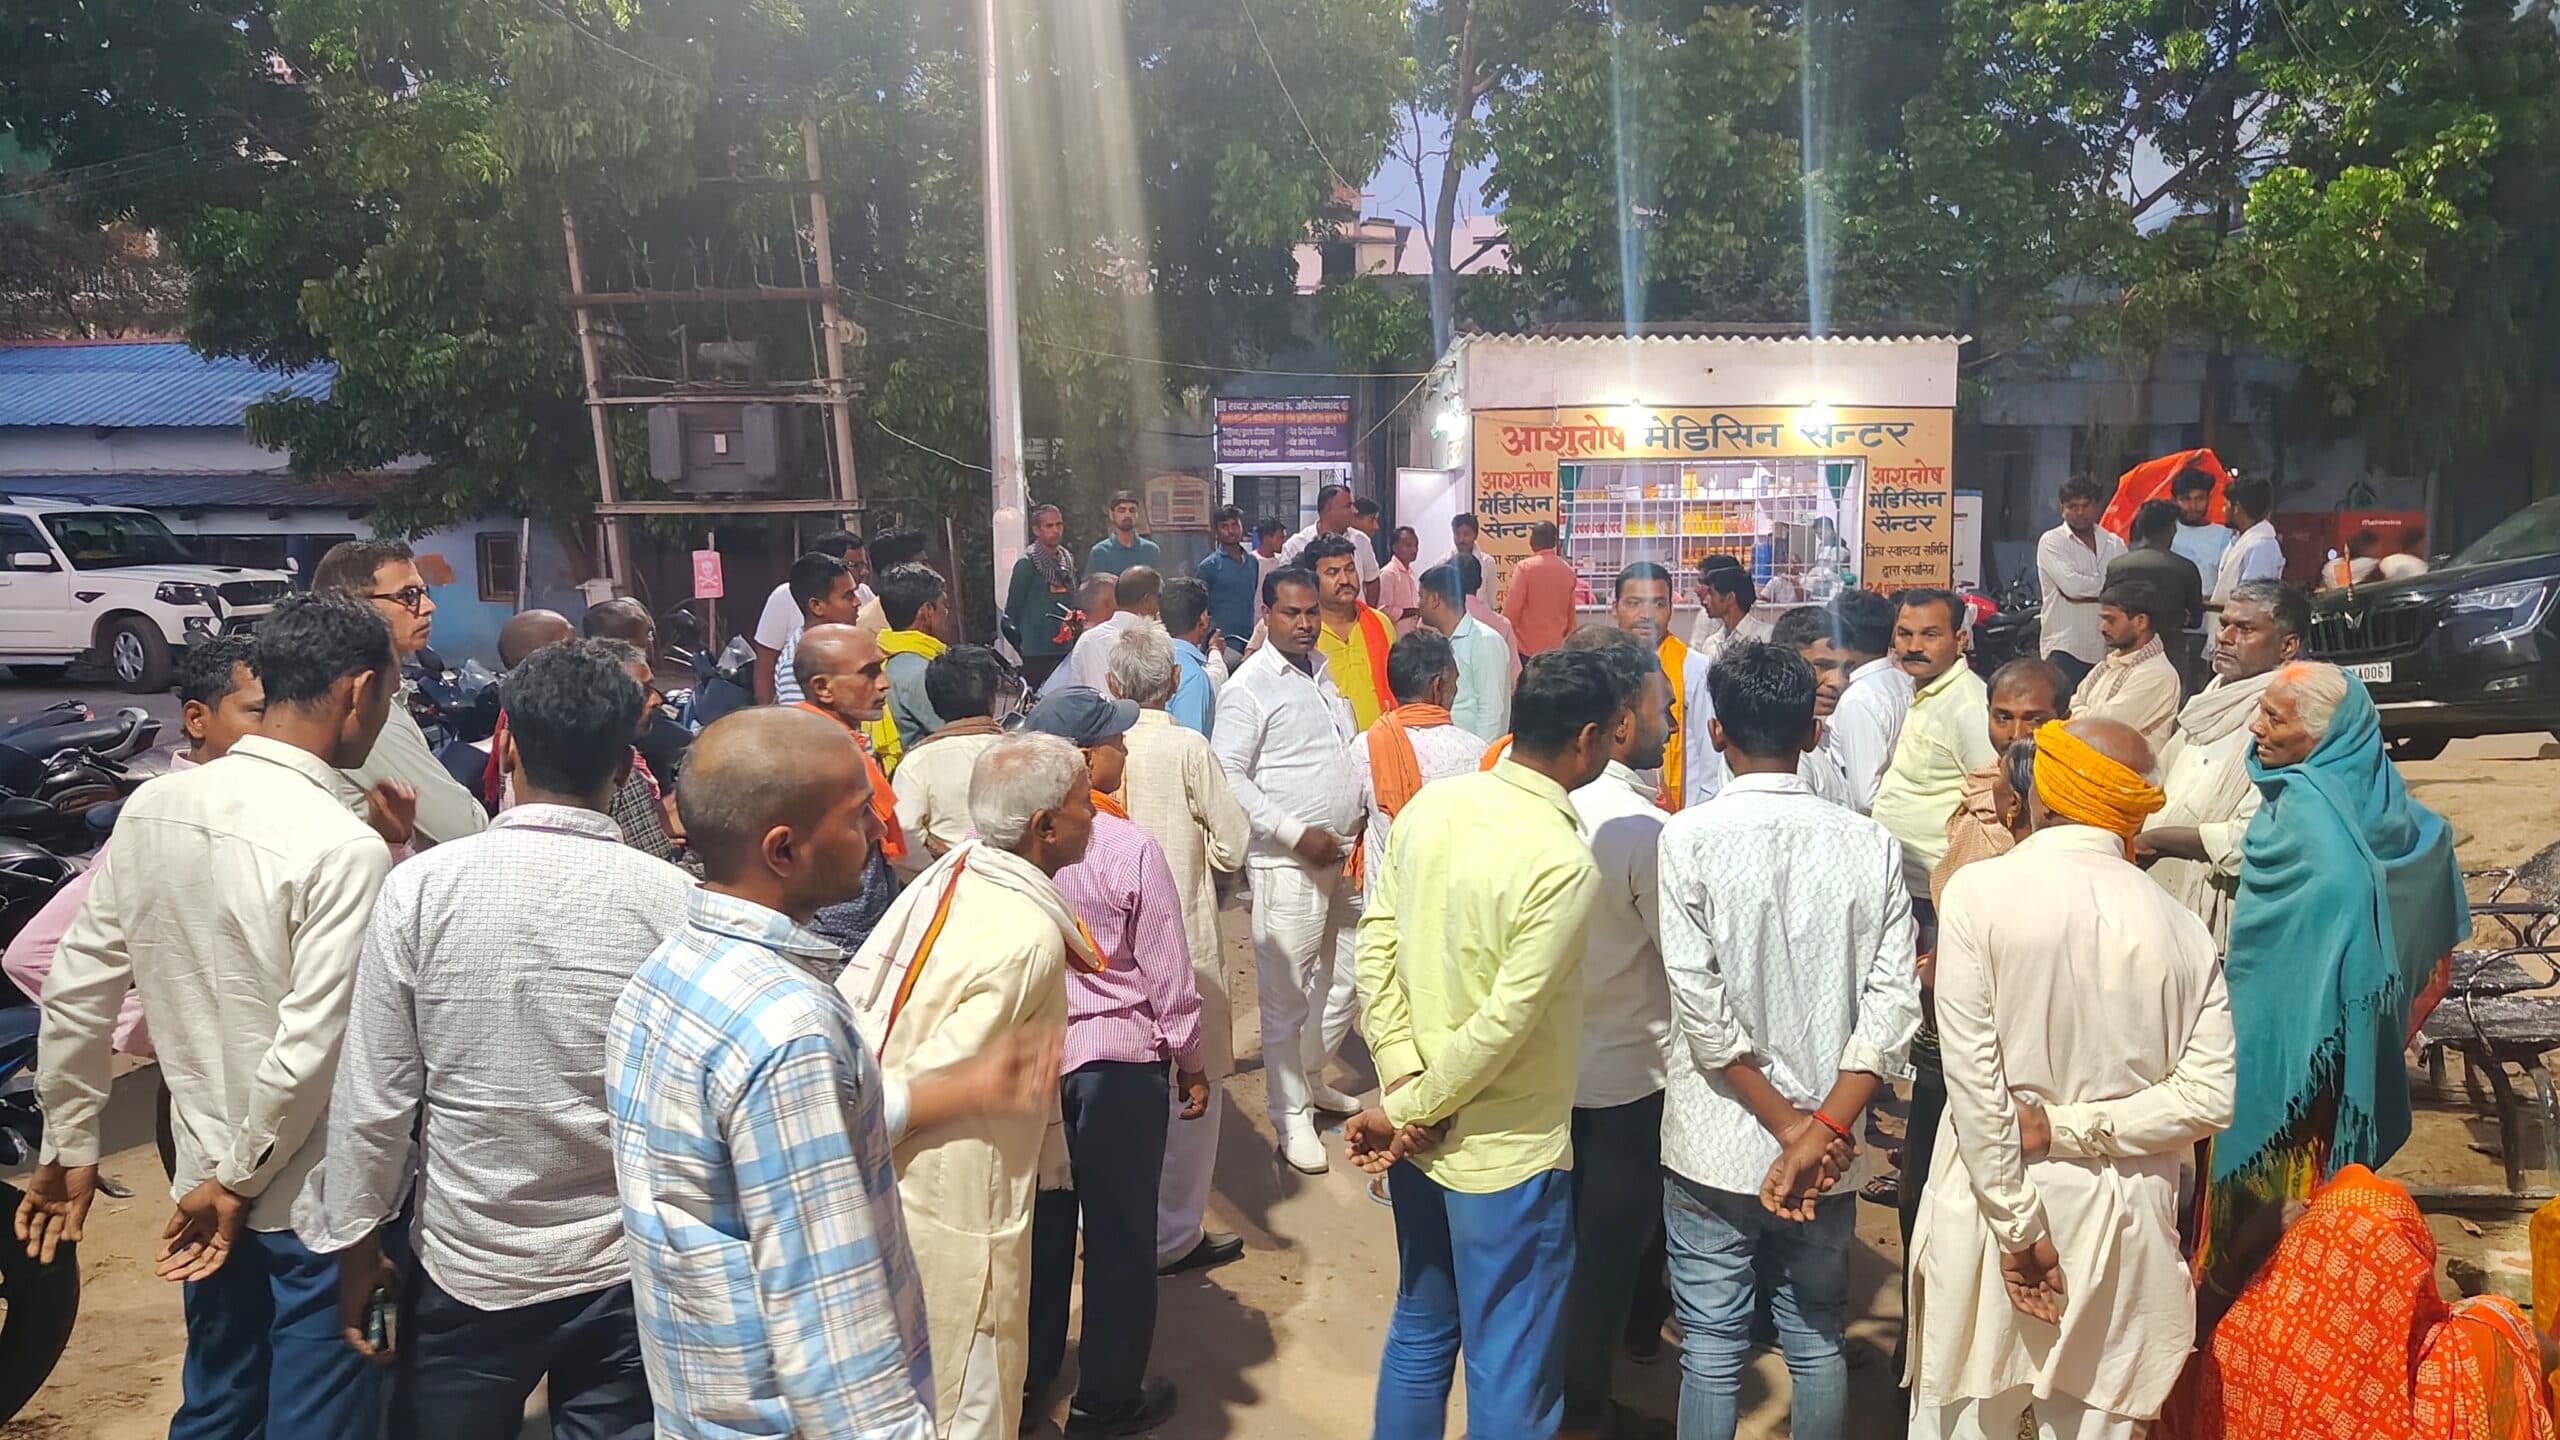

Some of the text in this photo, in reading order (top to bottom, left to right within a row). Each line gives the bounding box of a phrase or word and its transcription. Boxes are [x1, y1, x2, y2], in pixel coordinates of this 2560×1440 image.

[1501, 415, 1624, 457] आशुतोष
[1644, 414, 1784, 452] मेडिसिन
[1801, 422, 1914, 448] सन्टर
[1480, 463, 1553, 492] आशुतोष
[1872, 458, 1945, 487] आशुतोष
[1478, 492, 1553, 515] मेडिसिन
[1868, 486, 1947, 509] मेडिसिन
[1480, 517, 1535, 539] सेन्ट
[1872, 510, 1936, 534] सेन्टर
[2352, 665, 2390, 680] A0061
